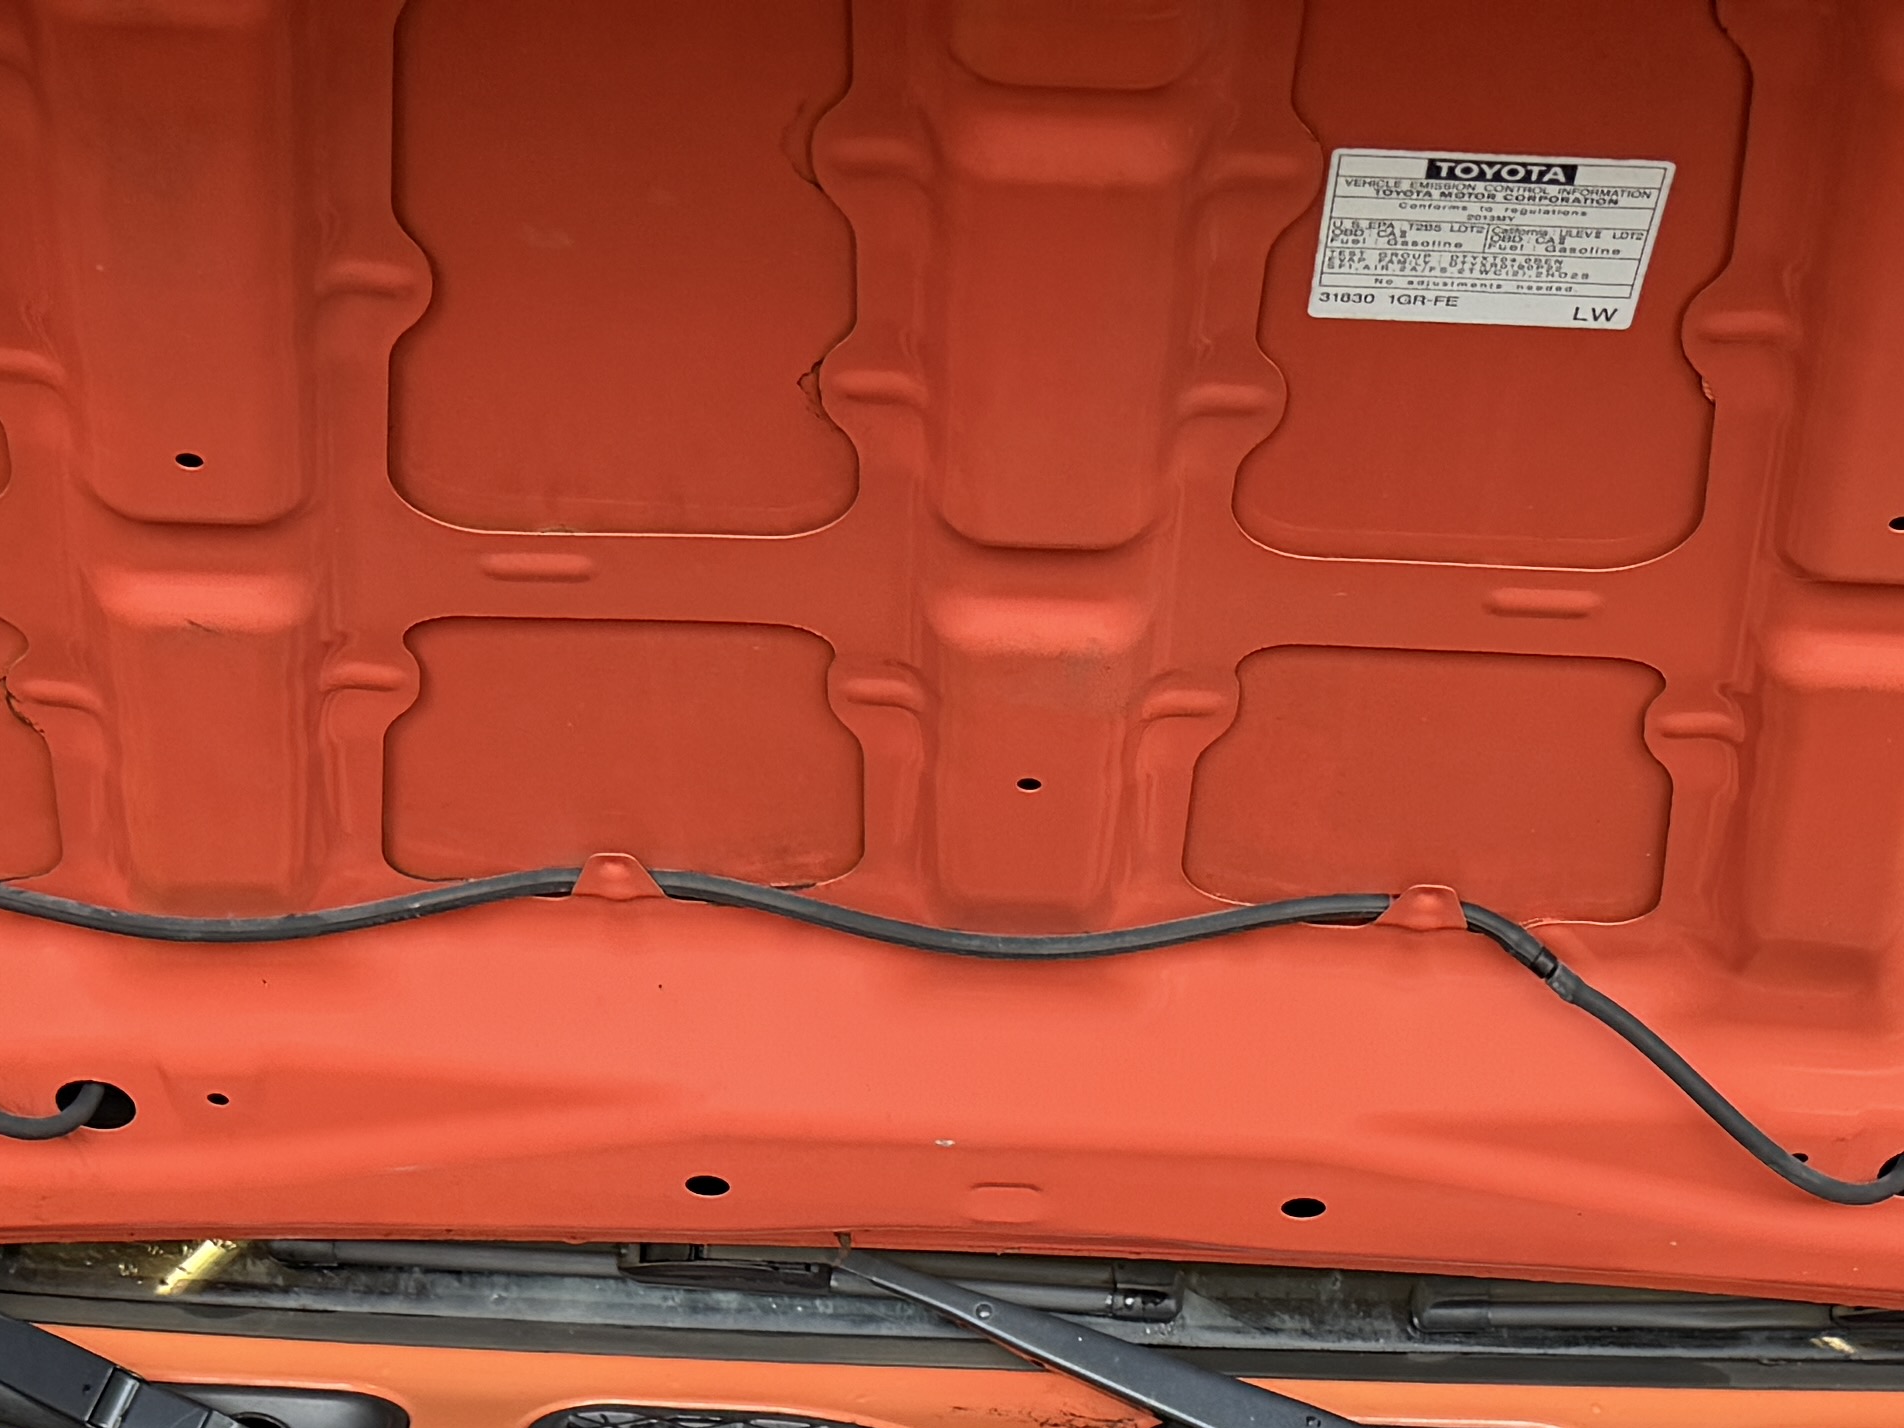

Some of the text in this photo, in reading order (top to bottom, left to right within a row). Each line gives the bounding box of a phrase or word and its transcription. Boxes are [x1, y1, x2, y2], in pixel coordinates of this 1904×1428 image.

[1436, 162, 1566, 183] TOYOTA
[1345, 179, 1652, 200] VEHICLE EMISSION CONTROL INFORMATION
[1375, 188, 1618, 206] TOYOTA MOTOR CORPORATION
[1398, 201, 1468, 211] Conforms
[1504, 207, 1588, 217] regulations
[1330, 237, 1464, 249] Fuel Gasoline
[1488, 243, 1621, 255] Fuel Gasoline
[1374, 278, 1394, 286] No
[1407, 280, 1504, 290] adjustments
[1389, 293, 1460, 307] 1GR-FE
[1573, 305, 1619, 322] LW
